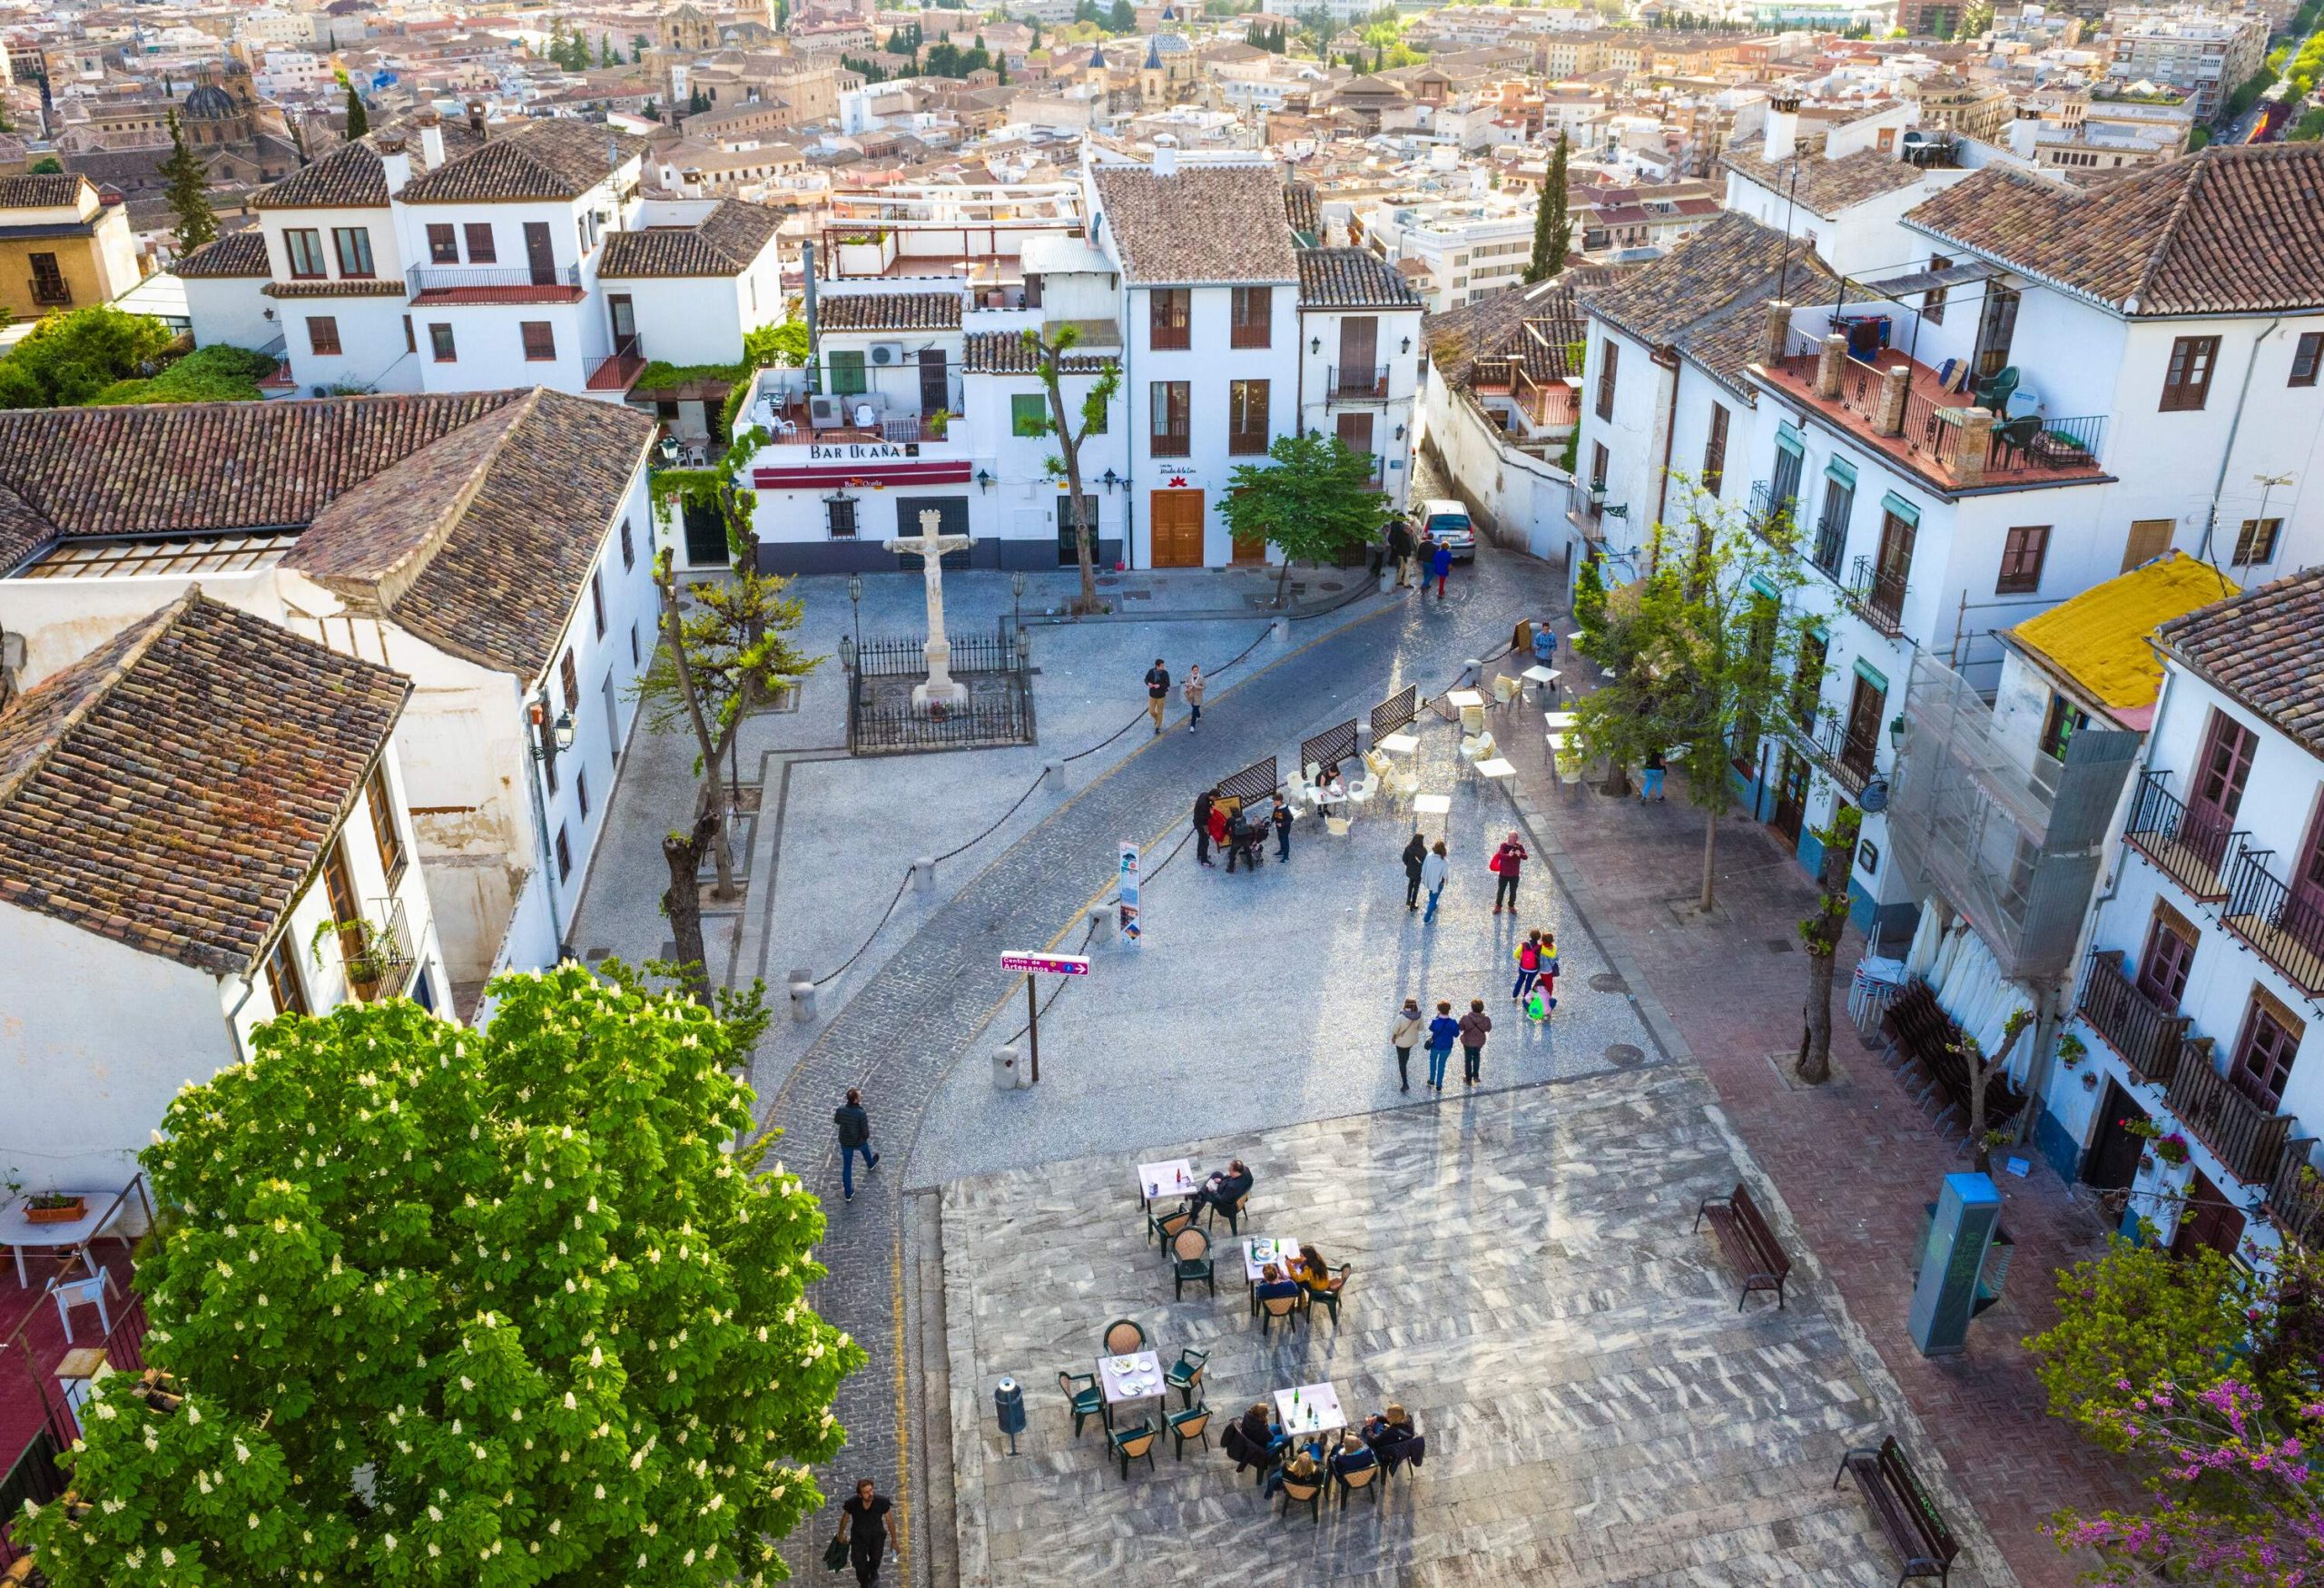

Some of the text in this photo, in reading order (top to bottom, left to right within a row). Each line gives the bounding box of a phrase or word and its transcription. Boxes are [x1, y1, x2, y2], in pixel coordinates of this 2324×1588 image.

[811, 444, 900, 459] BAR OCAÑA
[1004, 963, 1049, 972] Artesanos
